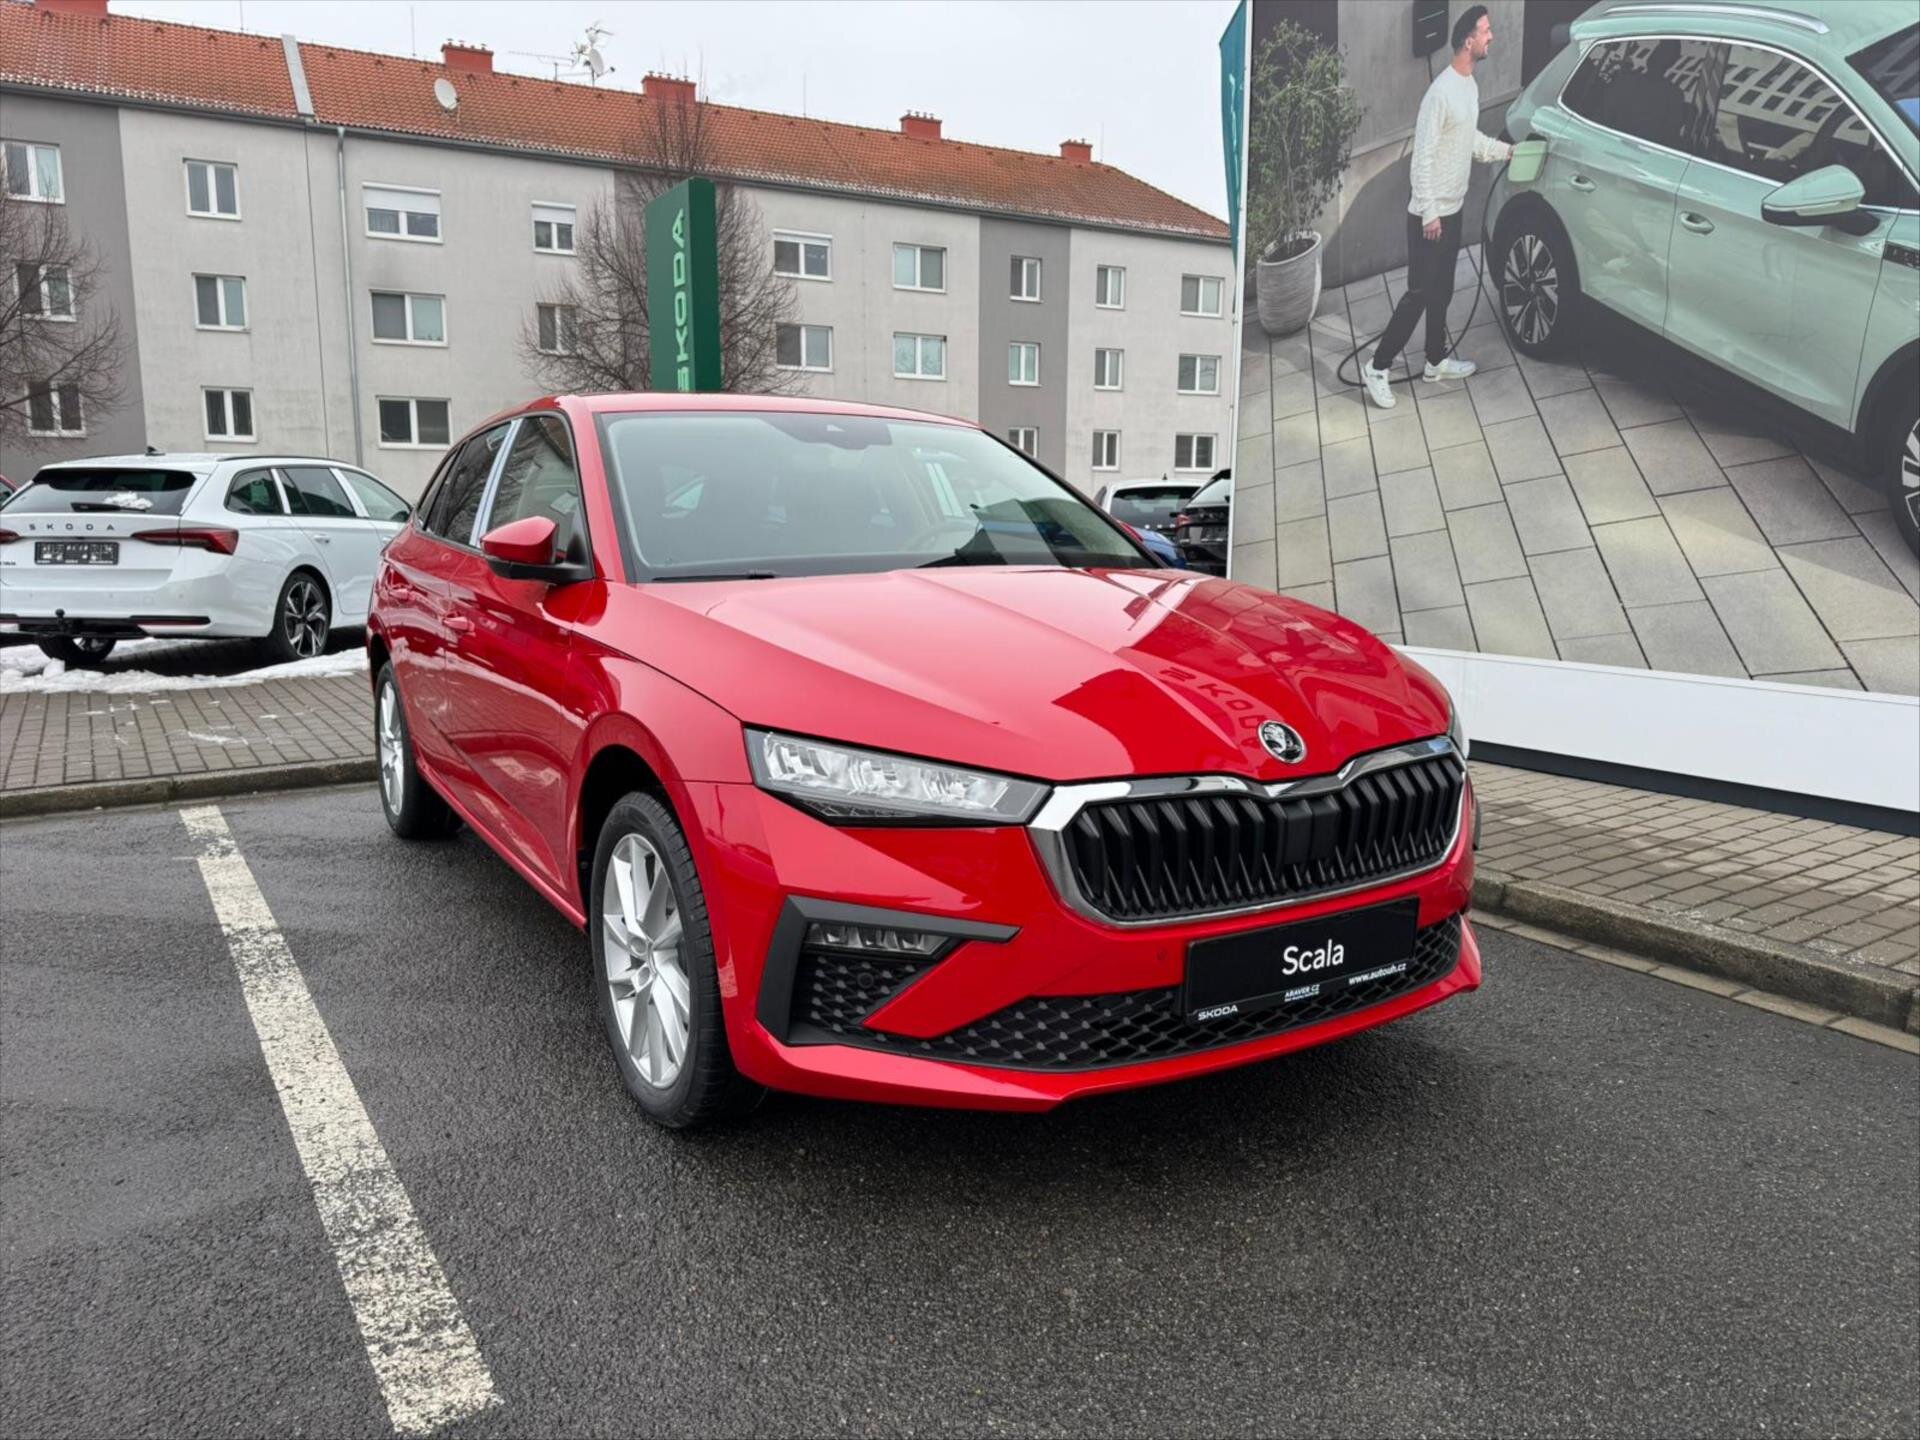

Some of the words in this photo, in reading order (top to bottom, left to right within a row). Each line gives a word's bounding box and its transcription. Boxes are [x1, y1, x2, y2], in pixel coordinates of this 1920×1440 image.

[29, 523, 115, 531] SKODA
[1282, 939, 1345, 975] Scala
[1198, 1004, 1238, 1021] SKODA
